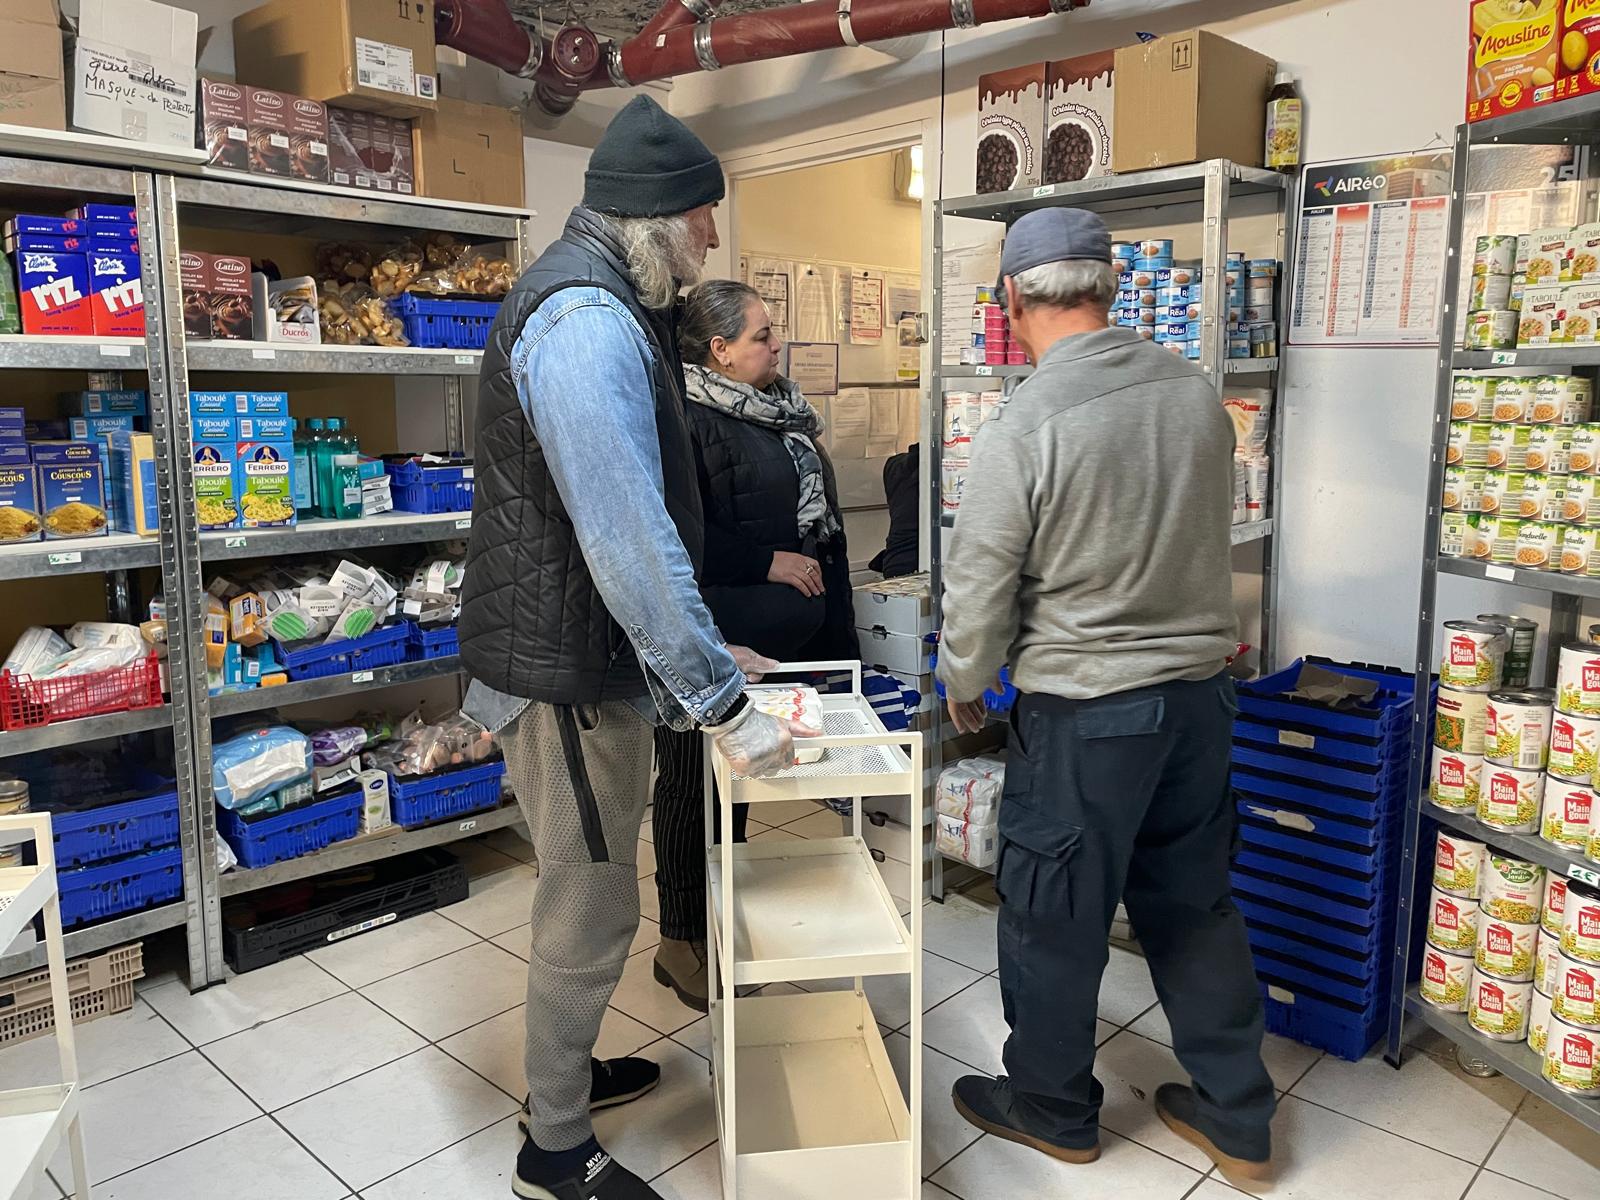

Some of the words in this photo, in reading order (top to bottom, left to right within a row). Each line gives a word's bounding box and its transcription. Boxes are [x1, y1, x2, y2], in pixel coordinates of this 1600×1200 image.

[1481, 24, 1551, 57] Mousline
[85, 73, 136, 101] MASQUE
[213, 86, 239, 98] Latino
[256, 94, 281, 106] Latino
[297, 102, 320, 113] Latino
[1333, 174, 1387, 194] AIRéO
[217, 262, 244, 272] Latino
[30, 275, 83, 312] riz
[282, 326, 309, 337] Ducros
[194, 394, 227, 402] Taboulé
[251, 394, 282, 402] Taboulé
[197, 419, 230, 427] Taboulé
[256, 419, 287, 427] Taboulé
[248, 463, 287, 471] FERRERO
[50, 470, 92, 480] COUSCOUS
[250, 477, 285, 485] Taboulé
[1452, 645, 1473, 657] Main
[1453, 654, 1475, 663] gourd
[1554, 728, 1570, 740] Main
[1554, 739, 1572, 749] gourd
[1441, 765, 1460, 776] Main
[1442, 774, 1463, 784] gourd
[1493, 781, 1513, 792] Main
[1494, 790, 1516, 801] gourd
[1567, 801, 1590, 813] Main
[1438, 849, 1451, 859] Main
[1438, 857, 1453, 867] gourd
[1437, 907, 1455, 919] Main
[1438, 917, 1457, 927] gourd
[1489, 931, 1509, 944] Main
[1490, 942, 1511, 953] gourd
[1427, 962, 1443, 974] Main
[1427, 971, 1444, 981] gourd
[1568, 978, 1590, 992] Main
[1481, 990, 1500, 1002] Main
[1569, 987, 1592, 1000] gourd
[1481, 1000, 1502, 1010] gourd
[1565, 1043, 1589, 1057] Main
[1566, 1054, 1591, 1065] gourd
[585, 1151, 602, 1169] MVP
